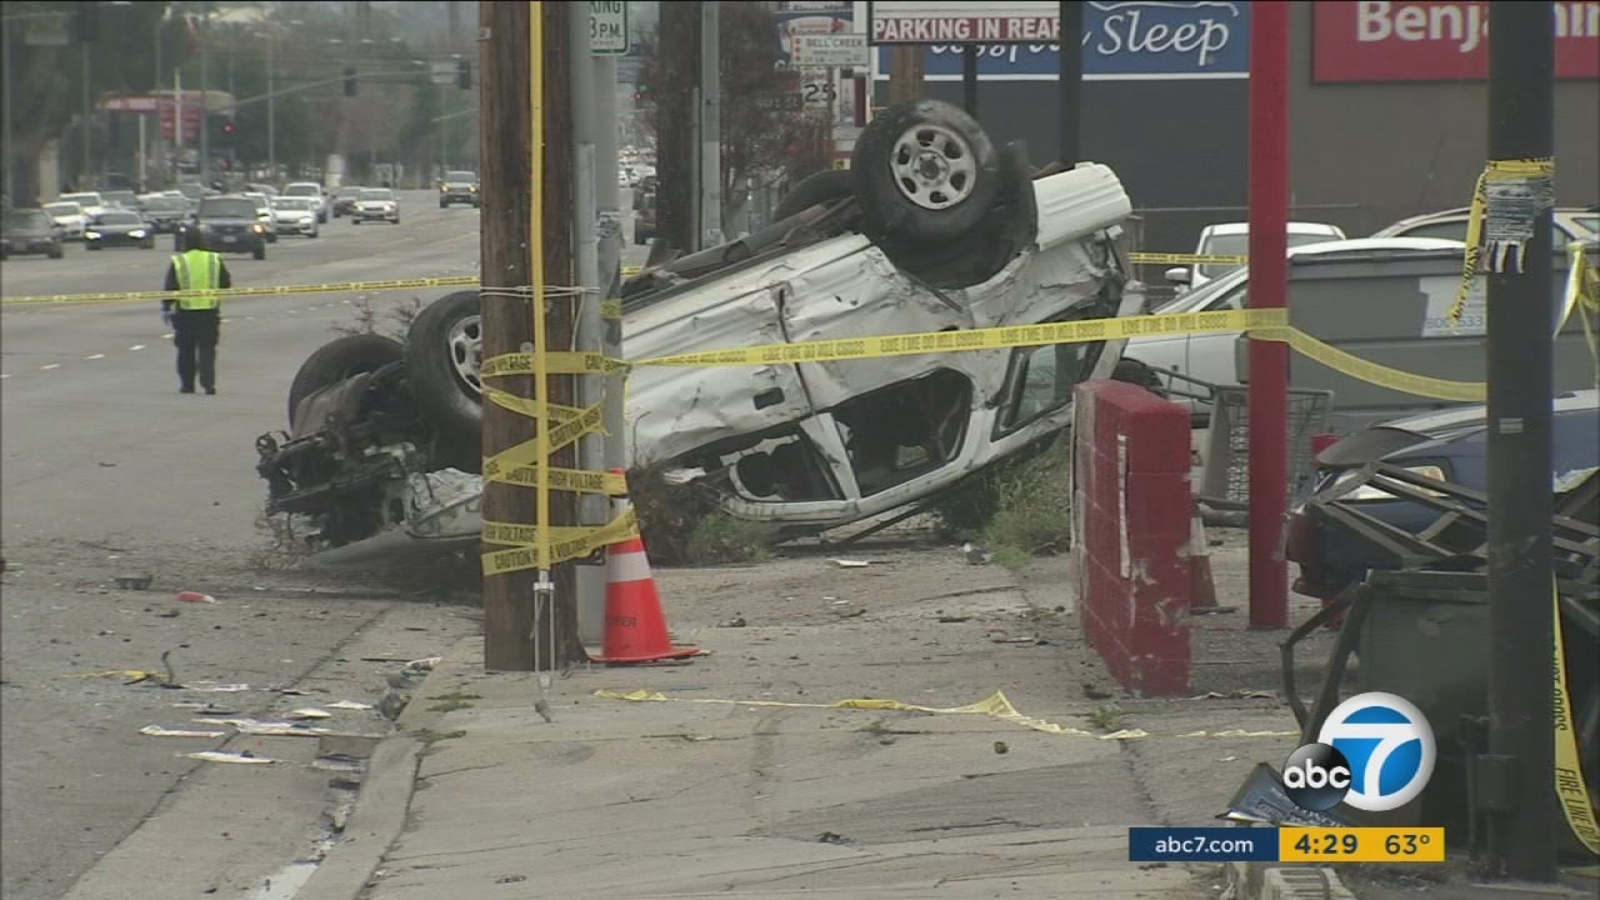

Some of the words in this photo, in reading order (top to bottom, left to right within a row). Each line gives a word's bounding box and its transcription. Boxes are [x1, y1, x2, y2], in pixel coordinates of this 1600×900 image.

[873, 19, 970, 39] PARKING
[978, 19, 1000, 38] IN
[1098, 10, 1229, 66] Sleep
[804, 83, 837, 102] 25
[494, 551, 530, 569] CAUTION
[1554, 766, 1583, 796] FIRE
